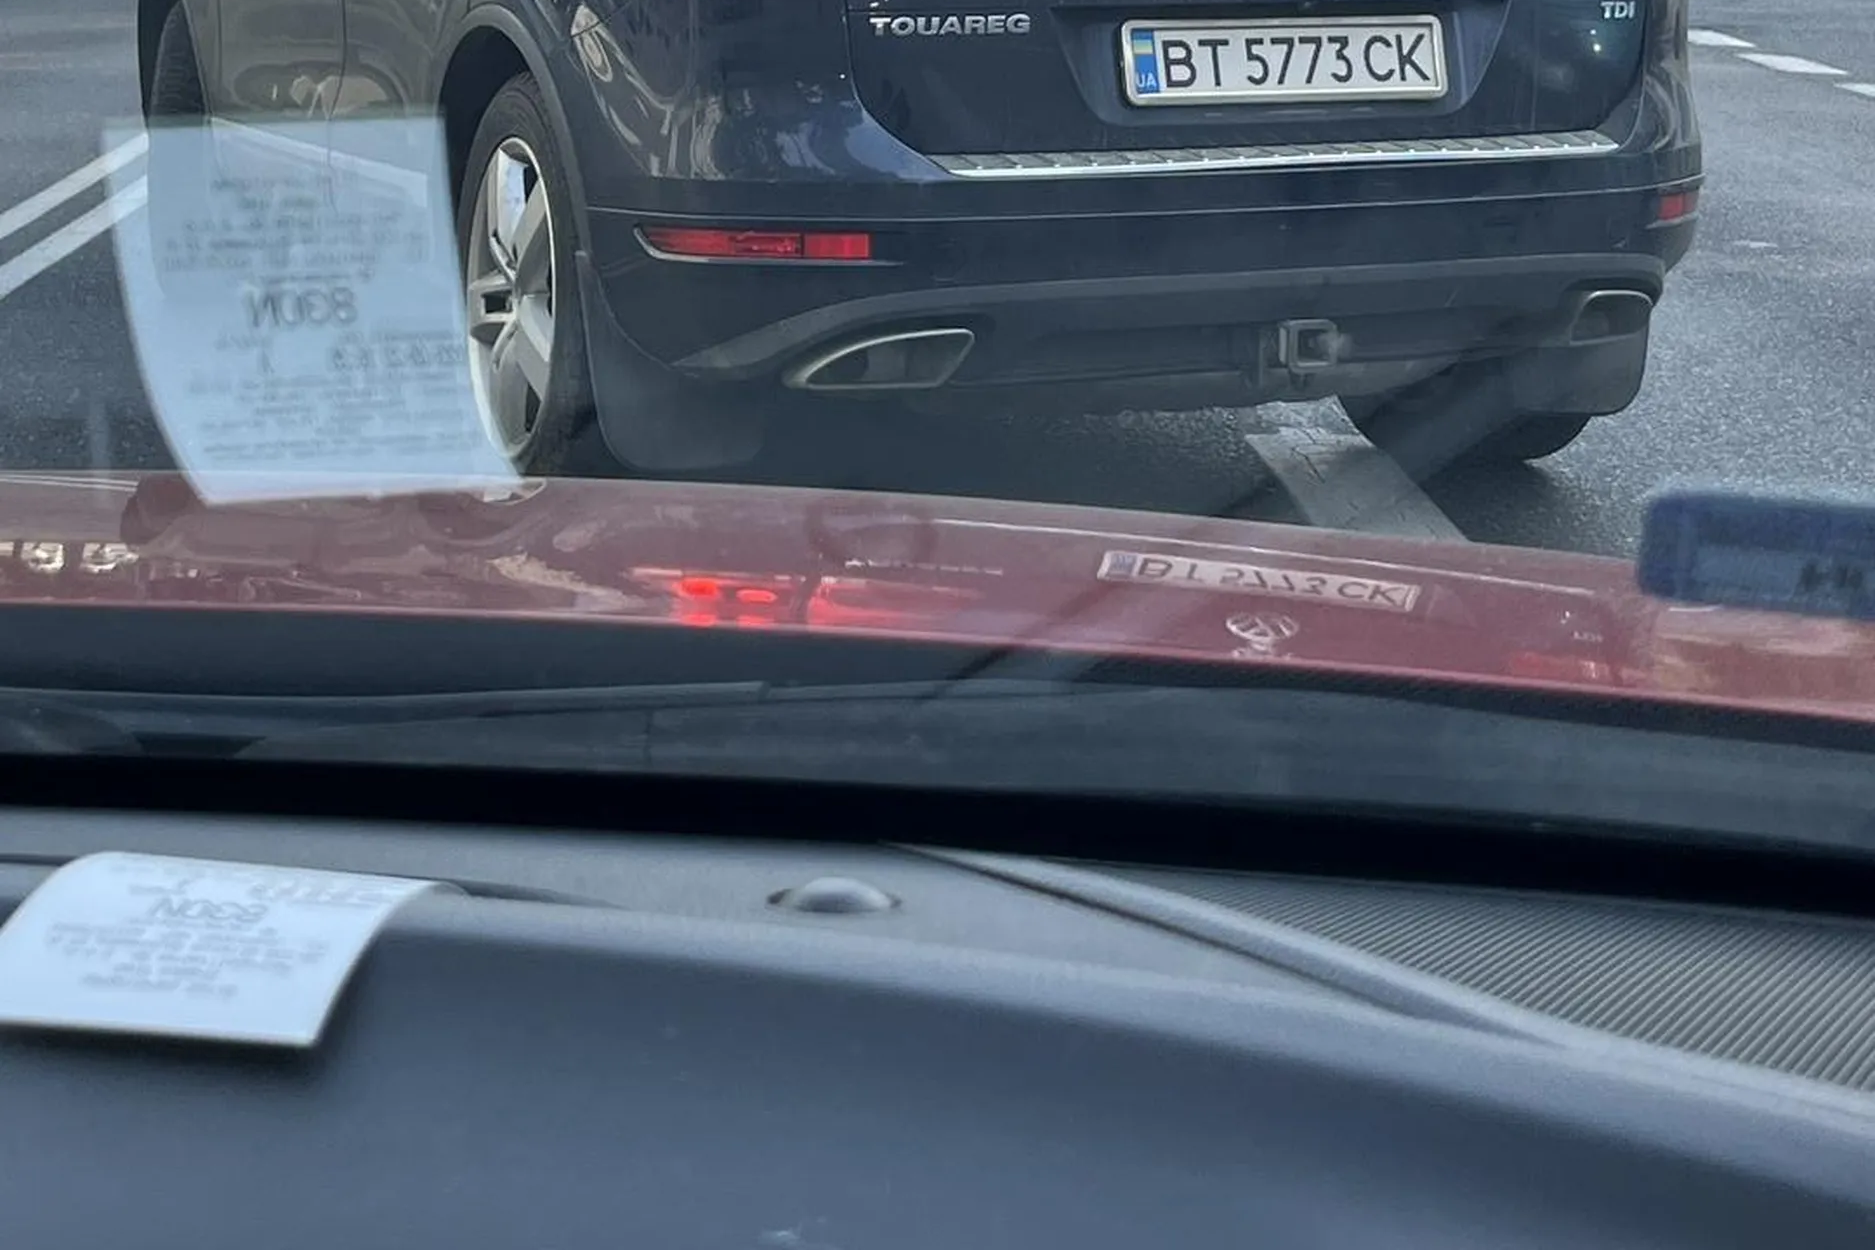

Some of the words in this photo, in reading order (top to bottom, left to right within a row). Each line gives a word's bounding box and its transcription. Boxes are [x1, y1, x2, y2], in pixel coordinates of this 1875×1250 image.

[1600, 0, 1636, 19] TDI
[869, 13, 1031, 37] TOUAREG
[1161, 38, 1230, 89] BT
[1244, 35, 1354, 86] 5773
[1363, 33, 1431, 83] CK
[1136, 72, 1158, 88] UA
